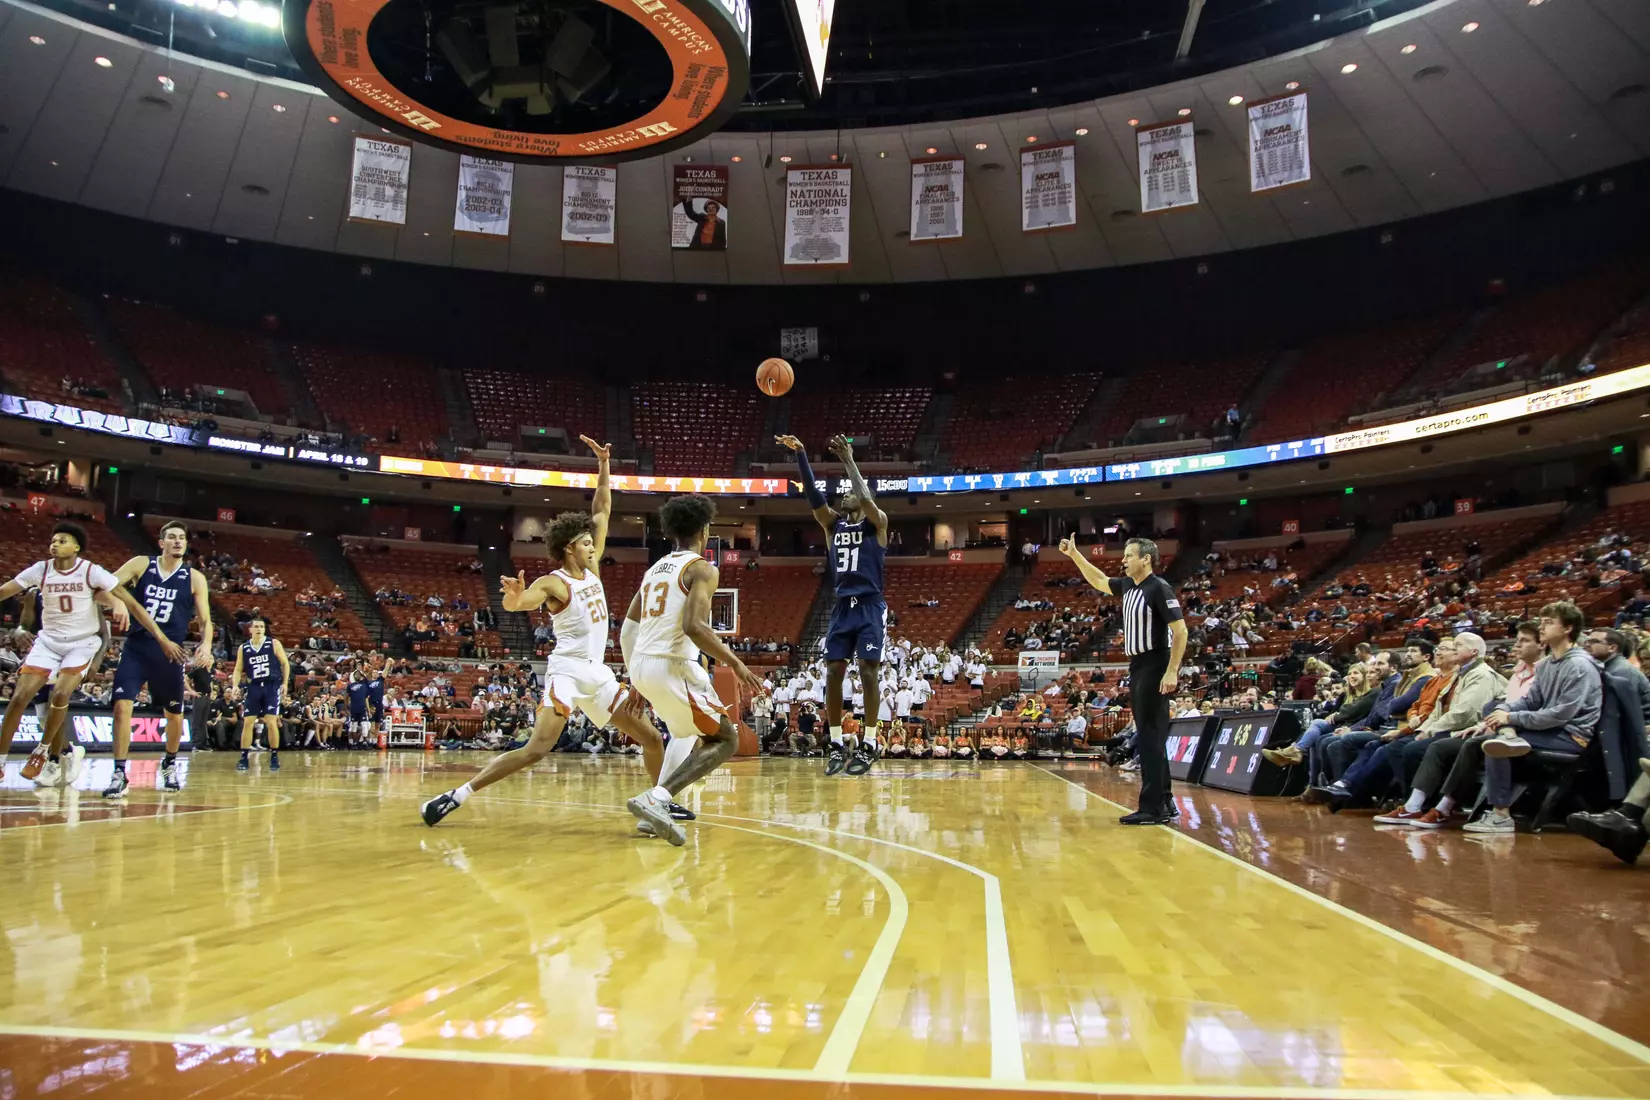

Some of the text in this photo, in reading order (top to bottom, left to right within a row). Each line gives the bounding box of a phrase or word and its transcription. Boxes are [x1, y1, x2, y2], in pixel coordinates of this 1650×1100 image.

[653, 14, 702, 54] CAMPUS
[664, 11, 713, 52] AMERICAN
[320, 37, 338, 64] Where
[342, 51, 359, 68] love
[685, 62, 708, 79] love
[346, 79, 404, 112] AMERICAN
[354, 77, 410, 112] CAMPUS
[688, 66, 726, 118] Where students
[1260, 98, 1294, 114] TEXAS
[1149, 126, 1182, 139] TEXAS
[1264, 124, 1292, 136] NCAA
[456, 134, 558, 155] Where students
[578, 130, 635, 149] CAMPUS
[585, 135, 640, 152] AMERICAN
[367, 141, 400, 154] TEXAS
[1032, 149, 1064, 160] TEXAS
[1152, 149, 1180, 160] NCAA
[472, 157, 504, 166] TEXAS
[924, 162, 954, 172] TEXAS
[362, 166, 400, 177] SOUTHWEST
[576, 167, 606, 176] TEXAS
[1144, 161, 1192, 175] APPEARANCES
[801, 170, 838, 180] TEXAS
[1036, 172, 1060, 180] NCAA
[460, 184, 510, 196] CHAMPIONSHIPS
[790, 188, 847, 199] NATIONAL
[924, 184, 948, 192] NCAA
[1026, 184, 1072, 194] APPEARANCES
[466, 195, 502, 206] 2002-03
[790, 198, 848, 208] CHAMPIONS
[916, 197, 960, 206] APPEARANCES
[465, 204, 502, 214] 2003-04
[569, 212, 608, 222] 2002-03
[1416, 412, 1488, 433] certapro.com
[1335, 430, 1390, 444] CertaPro Painters
[208, 436, 285, 456] MONSTER JAM
[298, 450, 330, 462] APRIL
[344, 455, 354, 464] &
[815, 480, 826, 492] 22
[877, 480, 888, 491] 15
[888, 480, 908, 490] CBU
[31, 496, 46, 506] 47
[1457, 502, 1470, 512] 39
[220, 512, 232, 520] 46
[1284, 522, 1297, 532] 40
[406, 530, 418, 538] 45
[834, 532, 862, 546] CBU
[726, 554, 738, 562] 43
[950, 553, 962, 561] 42
[1092, 548, 1104, 556] 41
[837, 547, 860, 572] 31
[46, 582, 84, 592] TEXAS
[146, 584, 178, 600] CBU
[60, 595, 73, 613] 0
[642, 581, 670, 618] 13
[146, 598, 174, 623] 33
[588, 599, 607, 623] 20
[249, 654, 268, 664] CBU
[253, 662, 270, 678] 25
[12, 732, 44, 742] EXT
[1234, 724, 1252, 746] 4:36
[1210, 752, 1220, 768] 22
[1247, 753, 1259, 773] 15
